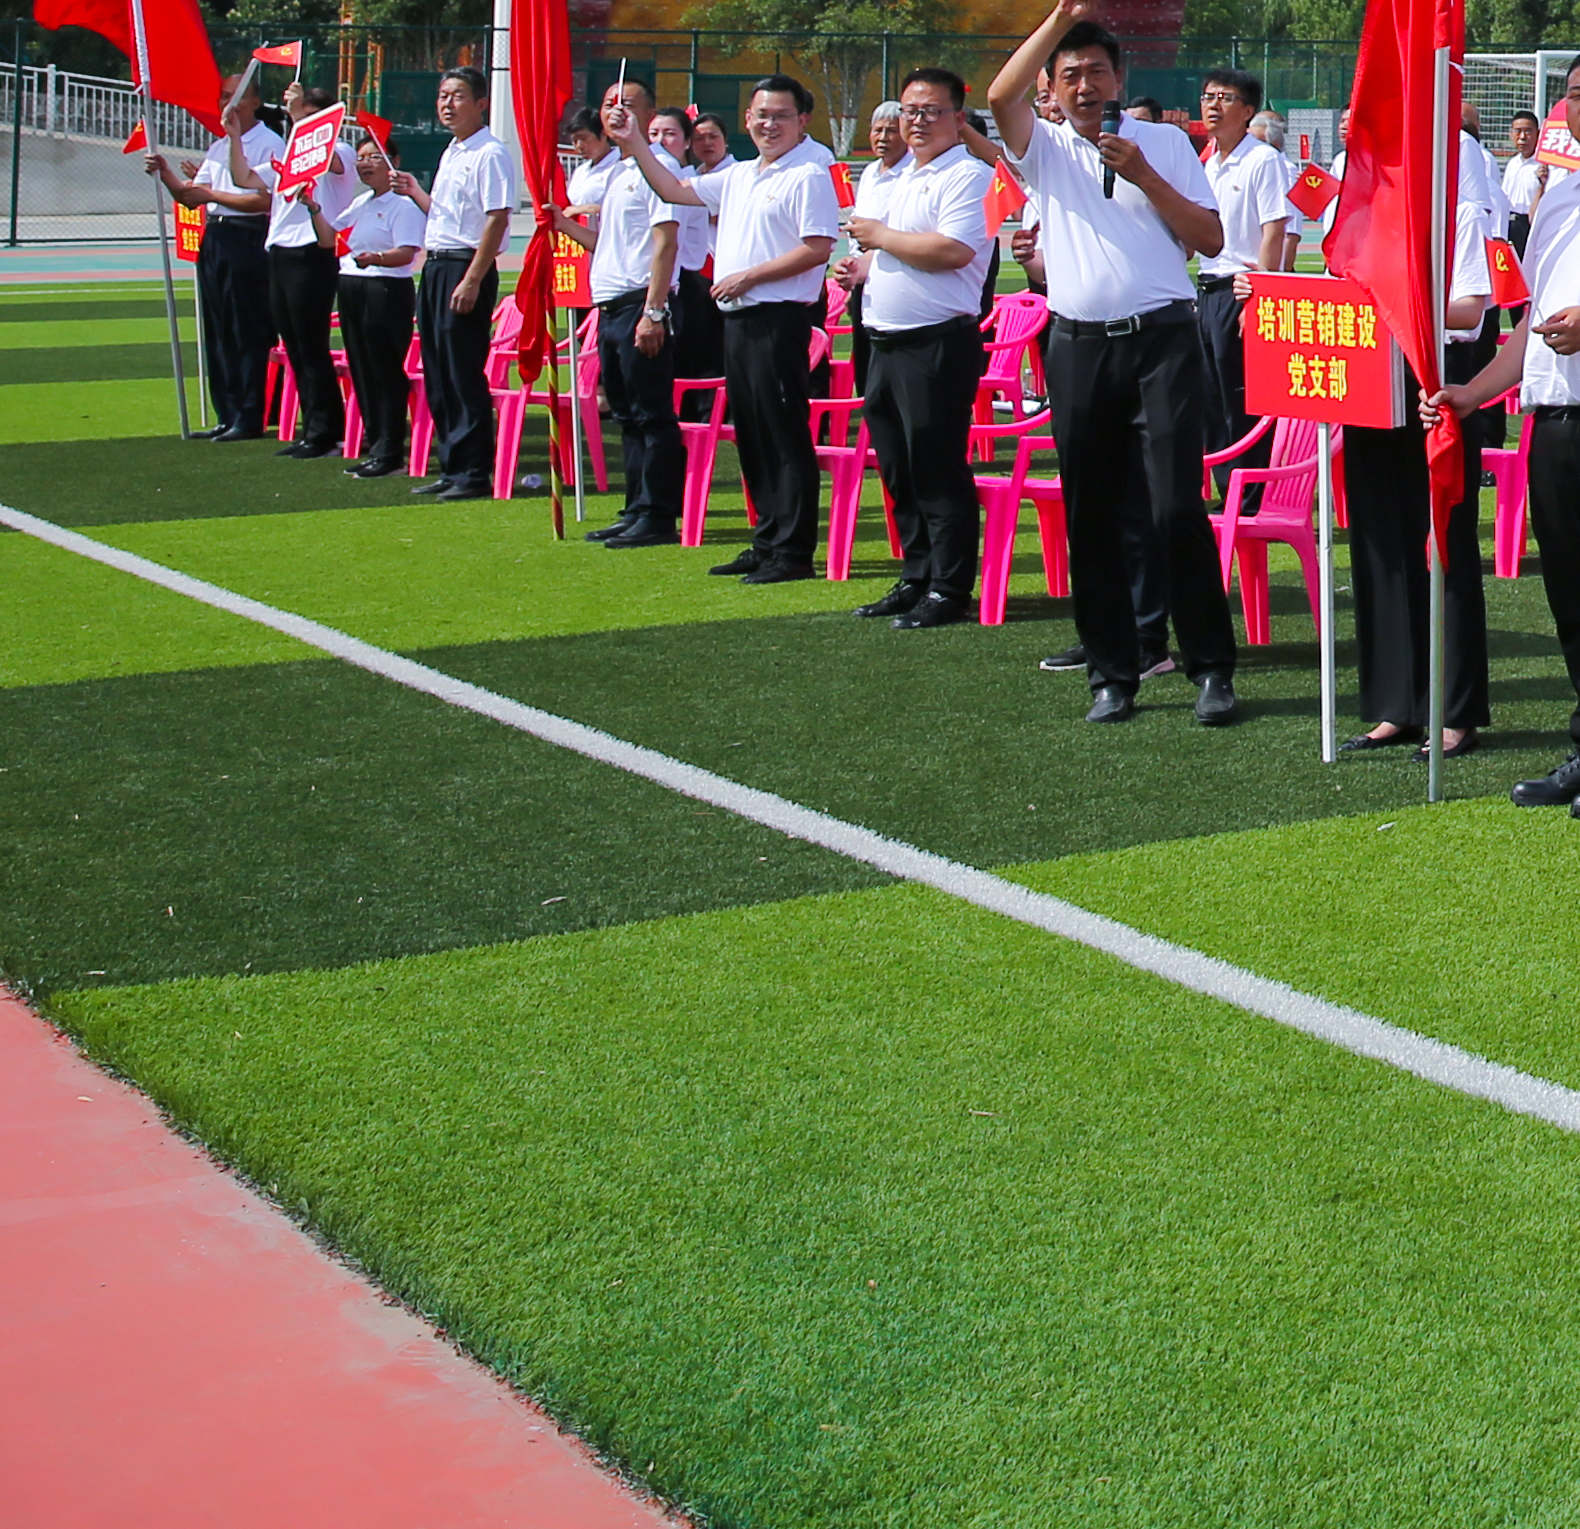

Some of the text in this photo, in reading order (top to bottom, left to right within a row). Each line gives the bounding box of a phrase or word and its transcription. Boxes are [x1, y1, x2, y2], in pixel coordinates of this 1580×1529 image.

[1257, 296, 1378, 349] 培训营销建设
[1288, 352, 1348, 402] 党支部
